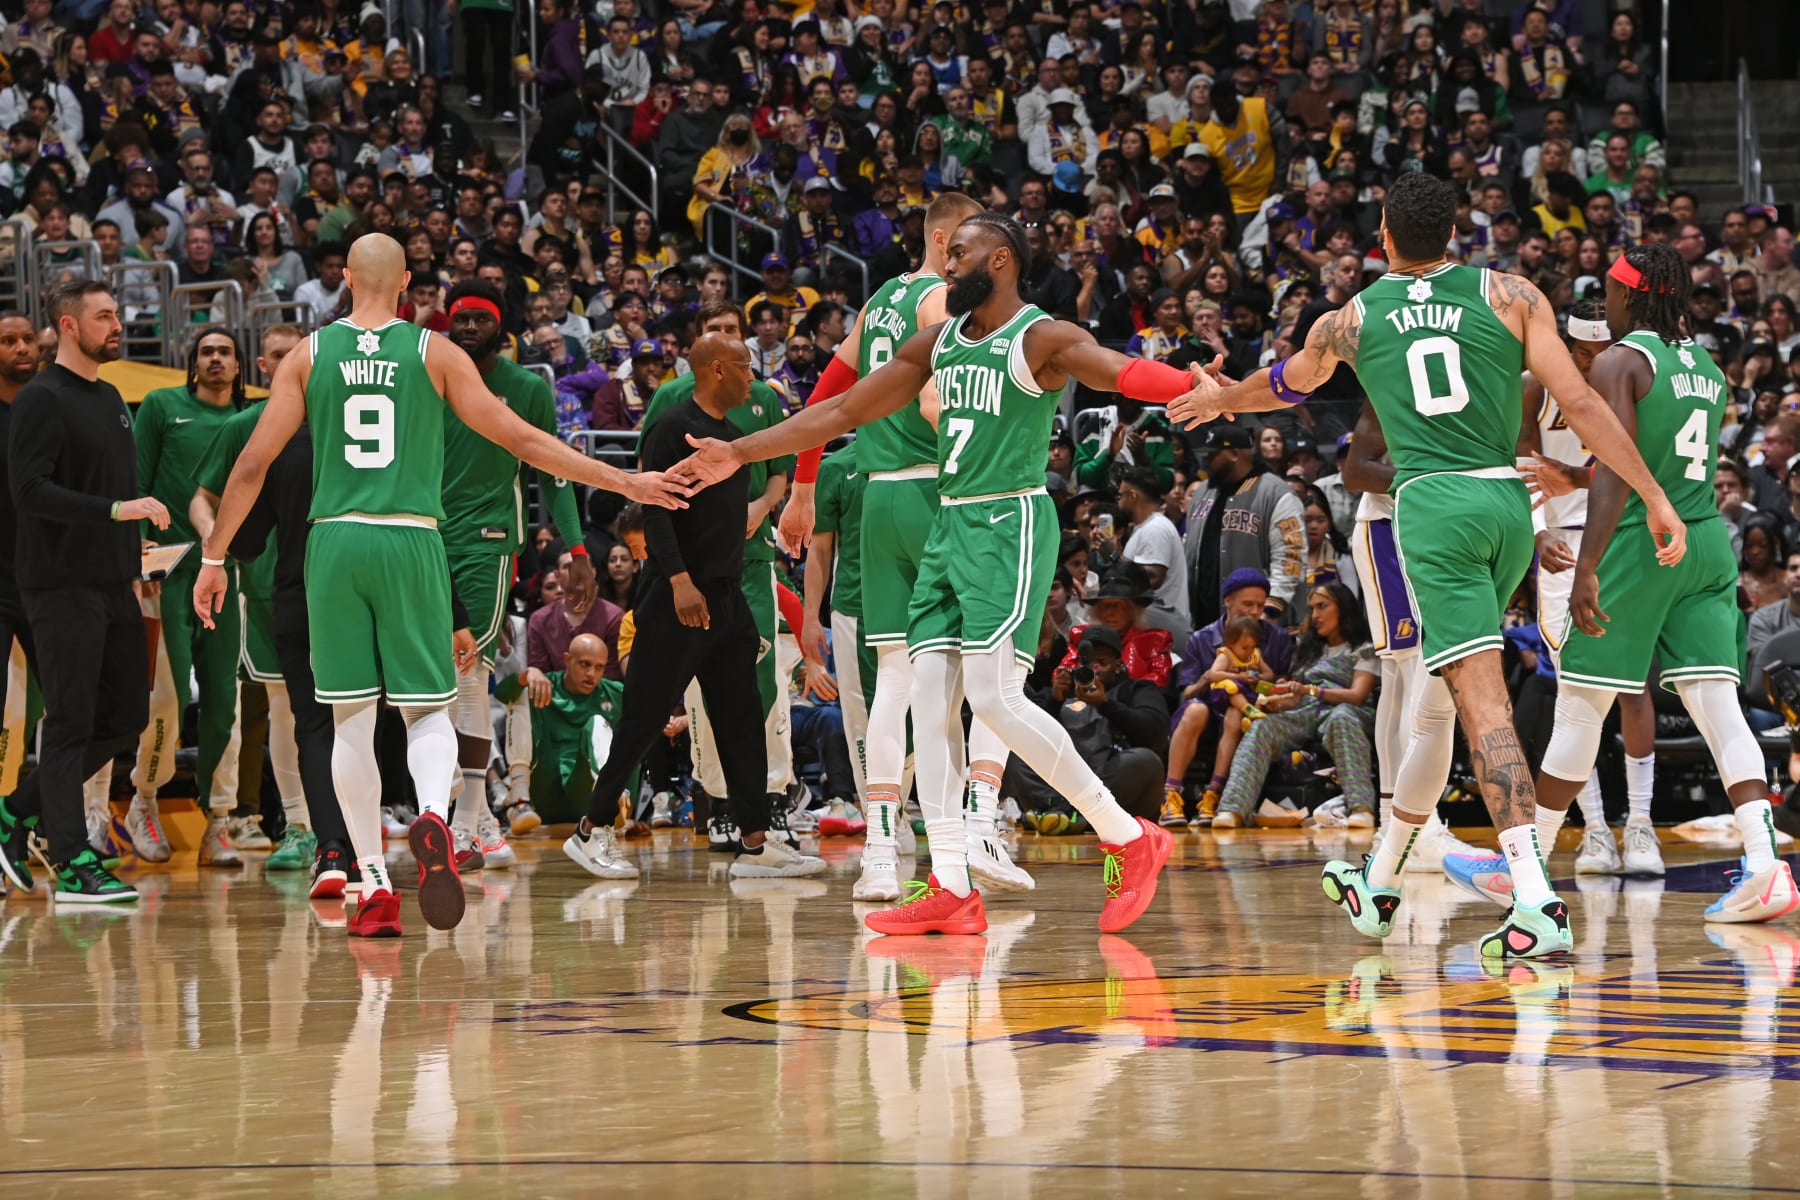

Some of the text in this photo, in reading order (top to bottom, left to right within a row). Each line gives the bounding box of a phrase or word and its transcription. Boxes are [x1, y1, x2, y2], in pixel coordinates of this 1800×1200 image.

[1385, 304, 1463, 334] TATUM
[338, 359, 399, 387] WHITE
[989, 347, 1008, 355] PRINT
[1406, 336, 1470, 416] 0
[1670, 372, 1722, 405] HOLIDAY
[344, 394, 395, 468] 9
[944, 417, 974, 474] 7
[1675, 408, 1709, 481] 4
[146, 718, 164, 783] BOSTON CELTICS
